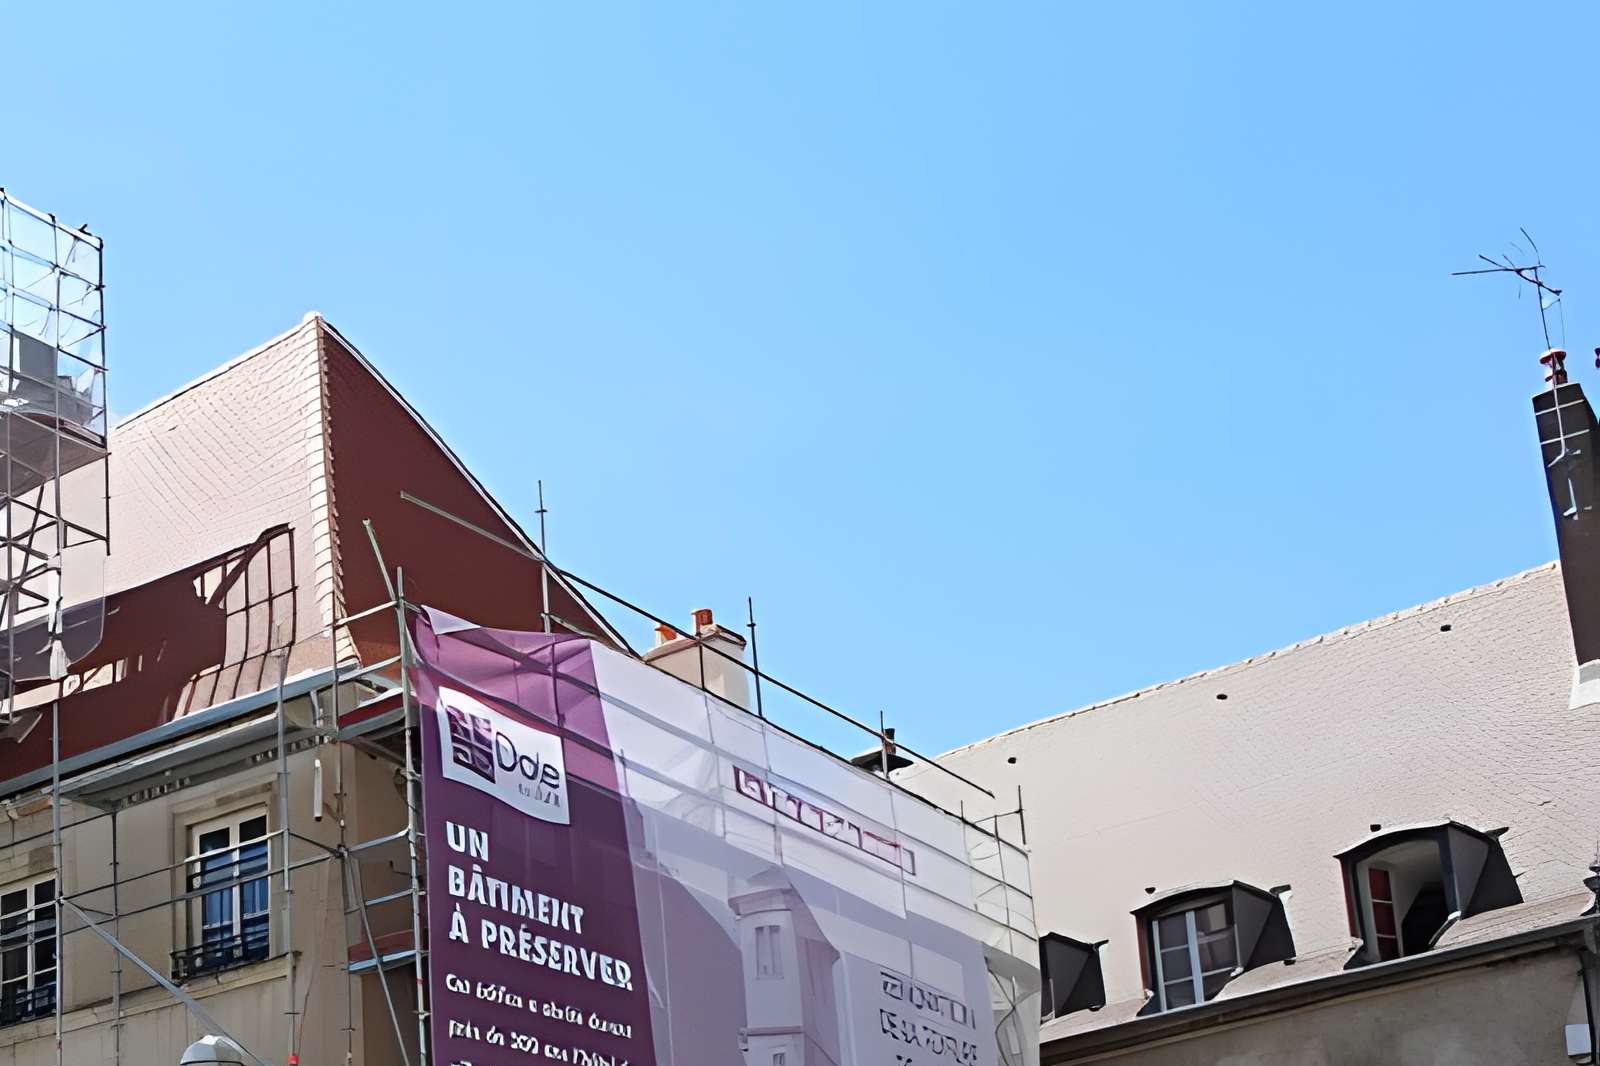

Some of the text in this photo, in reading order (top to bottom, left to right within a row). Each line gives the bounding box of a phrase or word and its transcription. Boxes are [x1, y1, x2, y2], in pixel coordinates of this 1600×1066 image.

[446, 820, 489, 862] UN
[448, 863, 584, 934] BÂTIMENT
[449, 902, 634, 991] À PRÉSERVER
